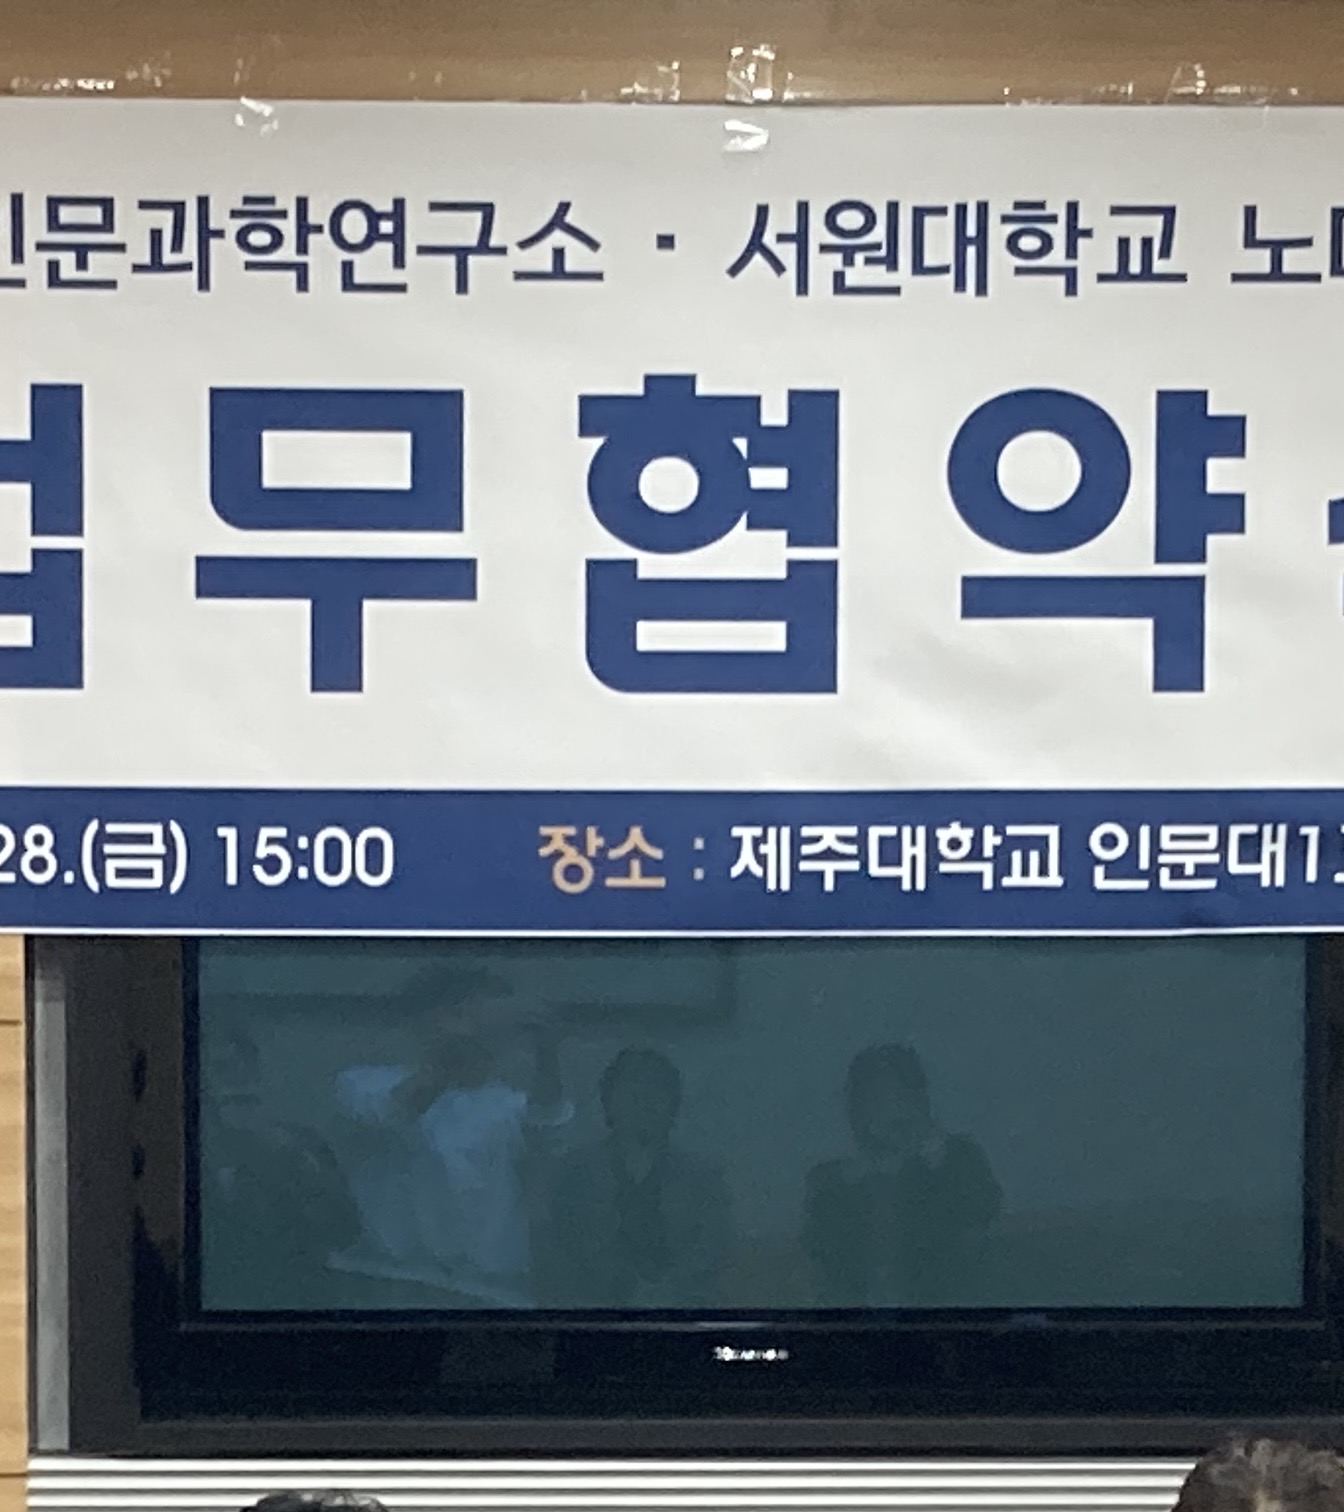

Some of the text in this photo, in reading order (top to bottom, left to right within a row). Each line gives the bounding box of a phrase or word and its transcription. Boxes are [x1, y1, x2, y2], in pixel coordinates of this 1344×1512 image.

[726, 199, 1189, 297] 서원대학교
[216, 826, 394, 887] 15:00
[538, 826, 666, 893] 장소
[730, 821, 1064, 892] 제주대학교
